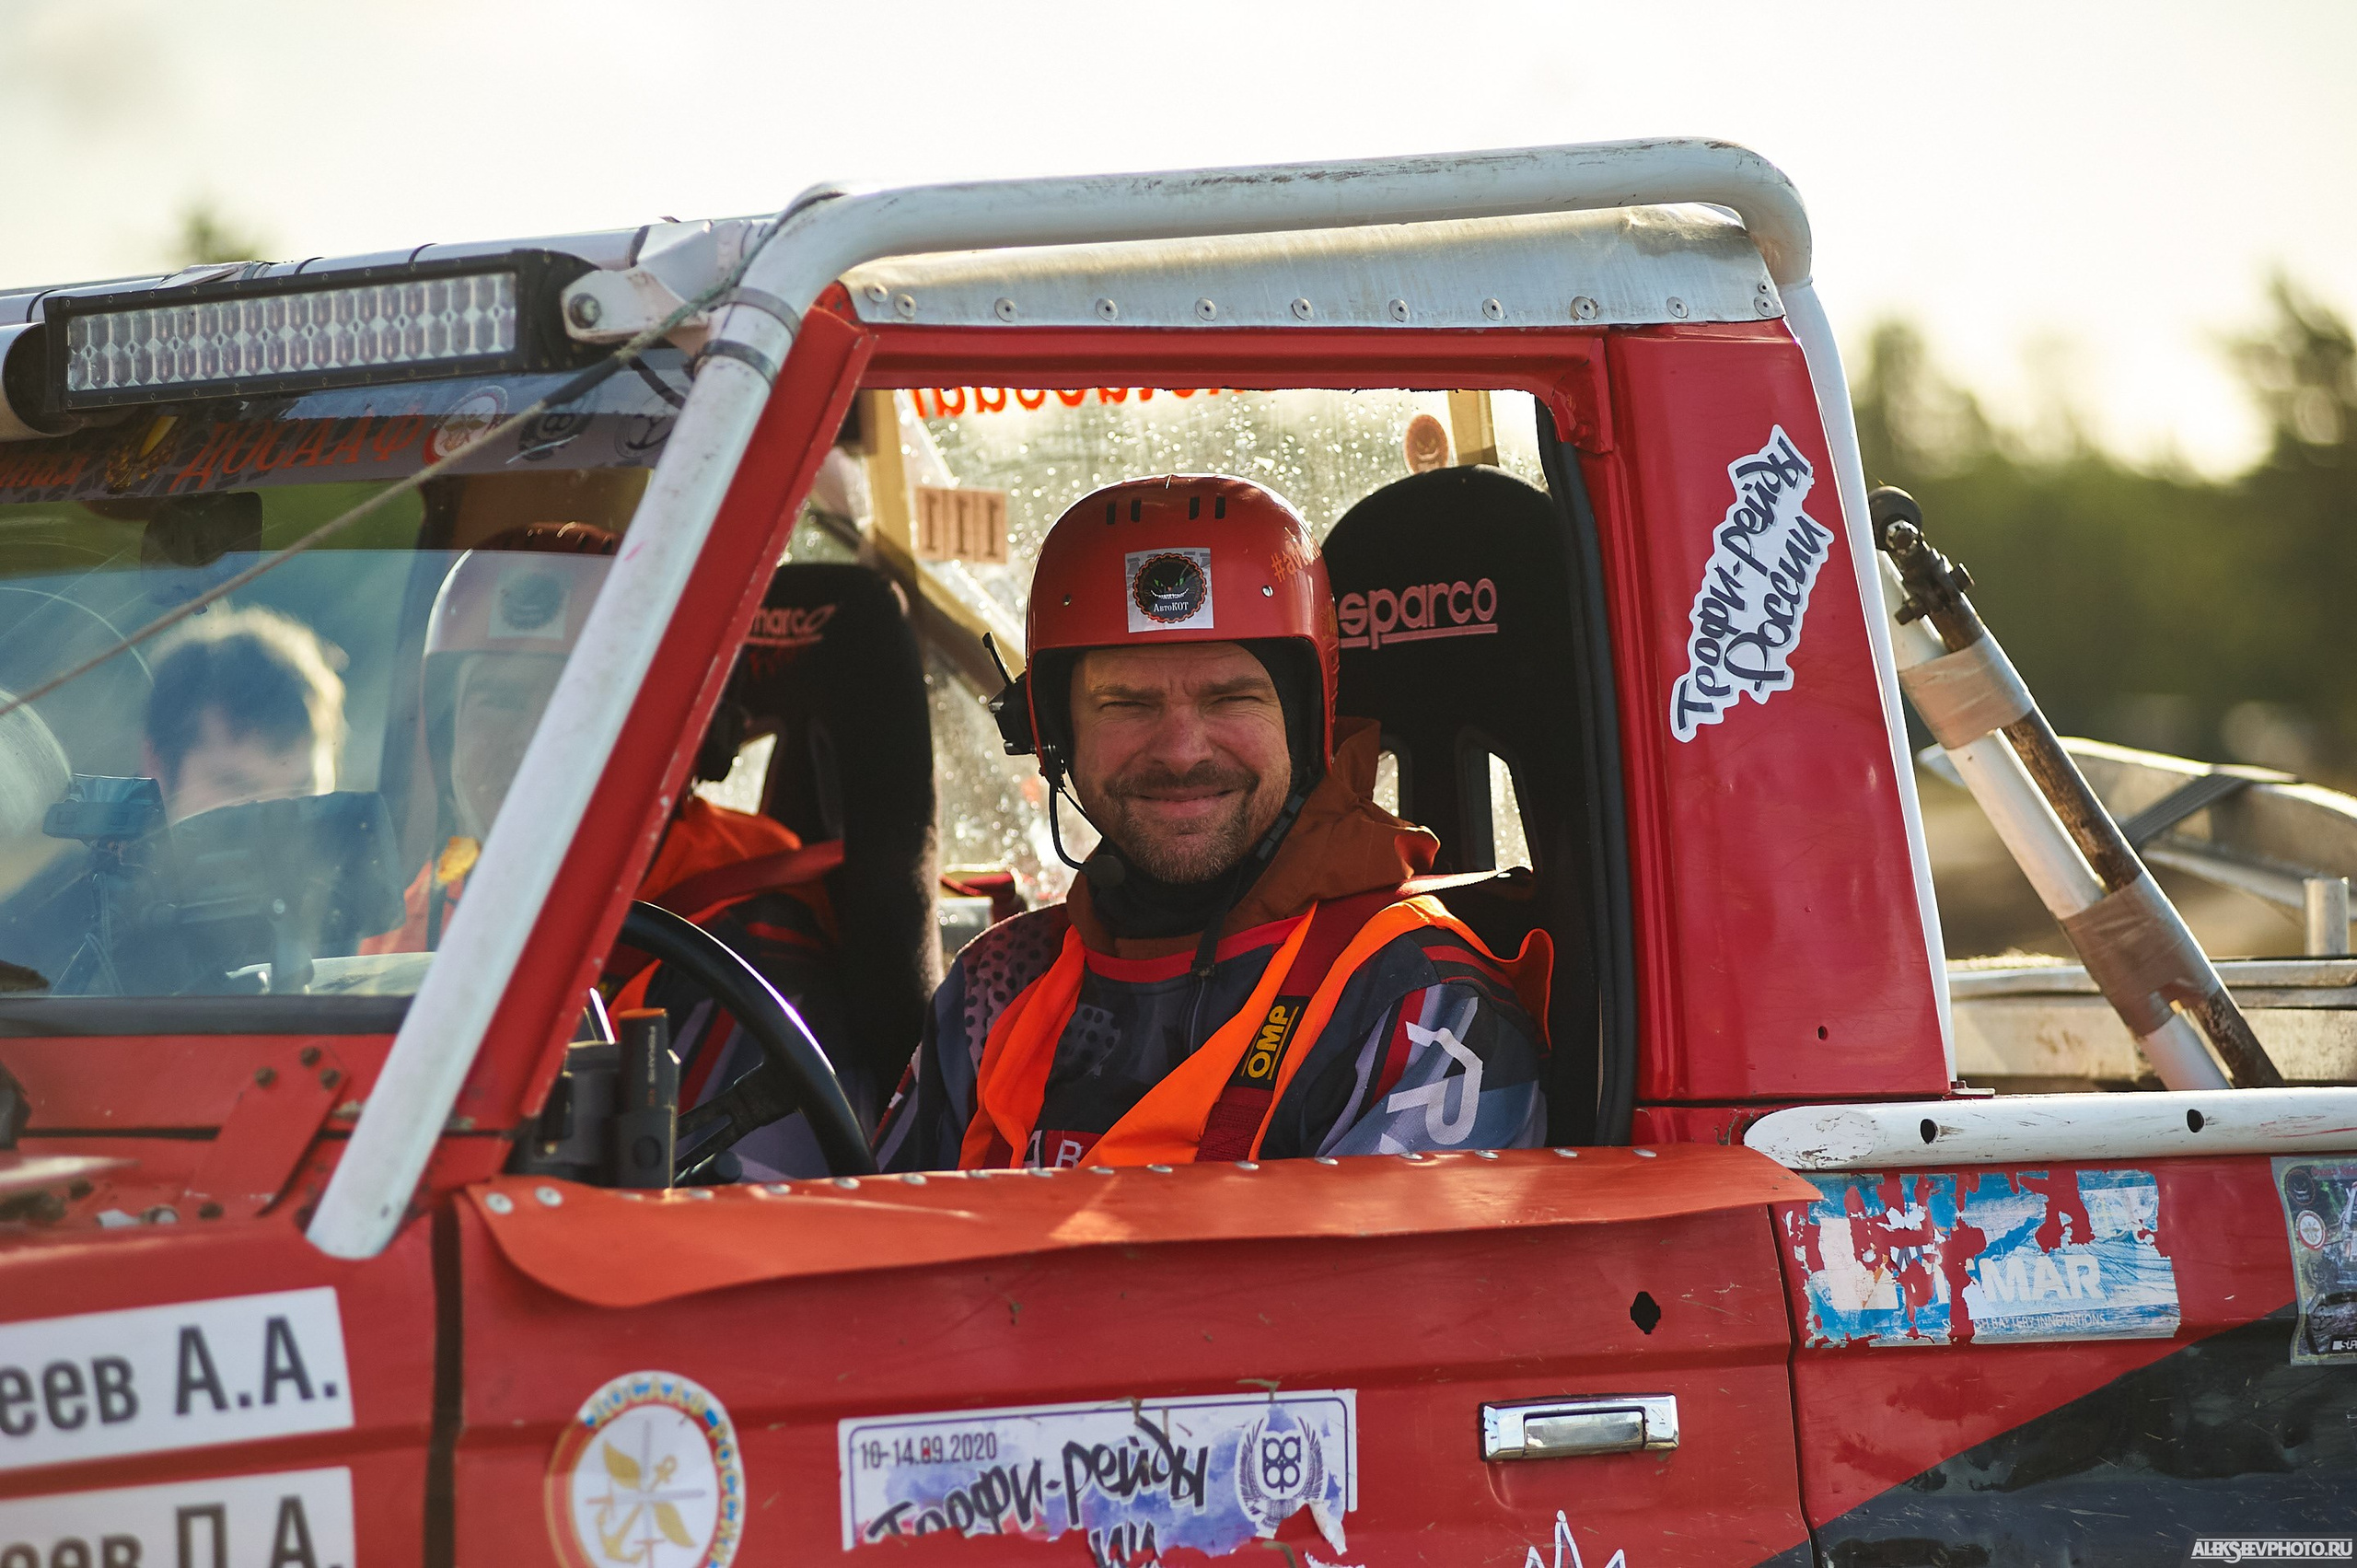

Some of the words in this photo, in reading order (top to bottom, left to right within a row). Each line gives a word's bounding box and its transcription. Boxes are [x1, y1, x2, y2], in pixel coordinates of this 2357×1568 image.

[168, 405, 426, 493] ДОСААФ
[749, 604, 837, 645] parco
[1154, 601, 1189, 612] АвтоКОТ
[1338, 577, 1498, 650] sparco
[1724, 516, 1827, 691] России
[1248, 1005, 1288, 1079] OMP
[1970, 1255, 2102, 1302] MAR
[2036, 1312, 2107, 1328] INNOVATIONS
[175, 1314, 339, 1416] А.А.
